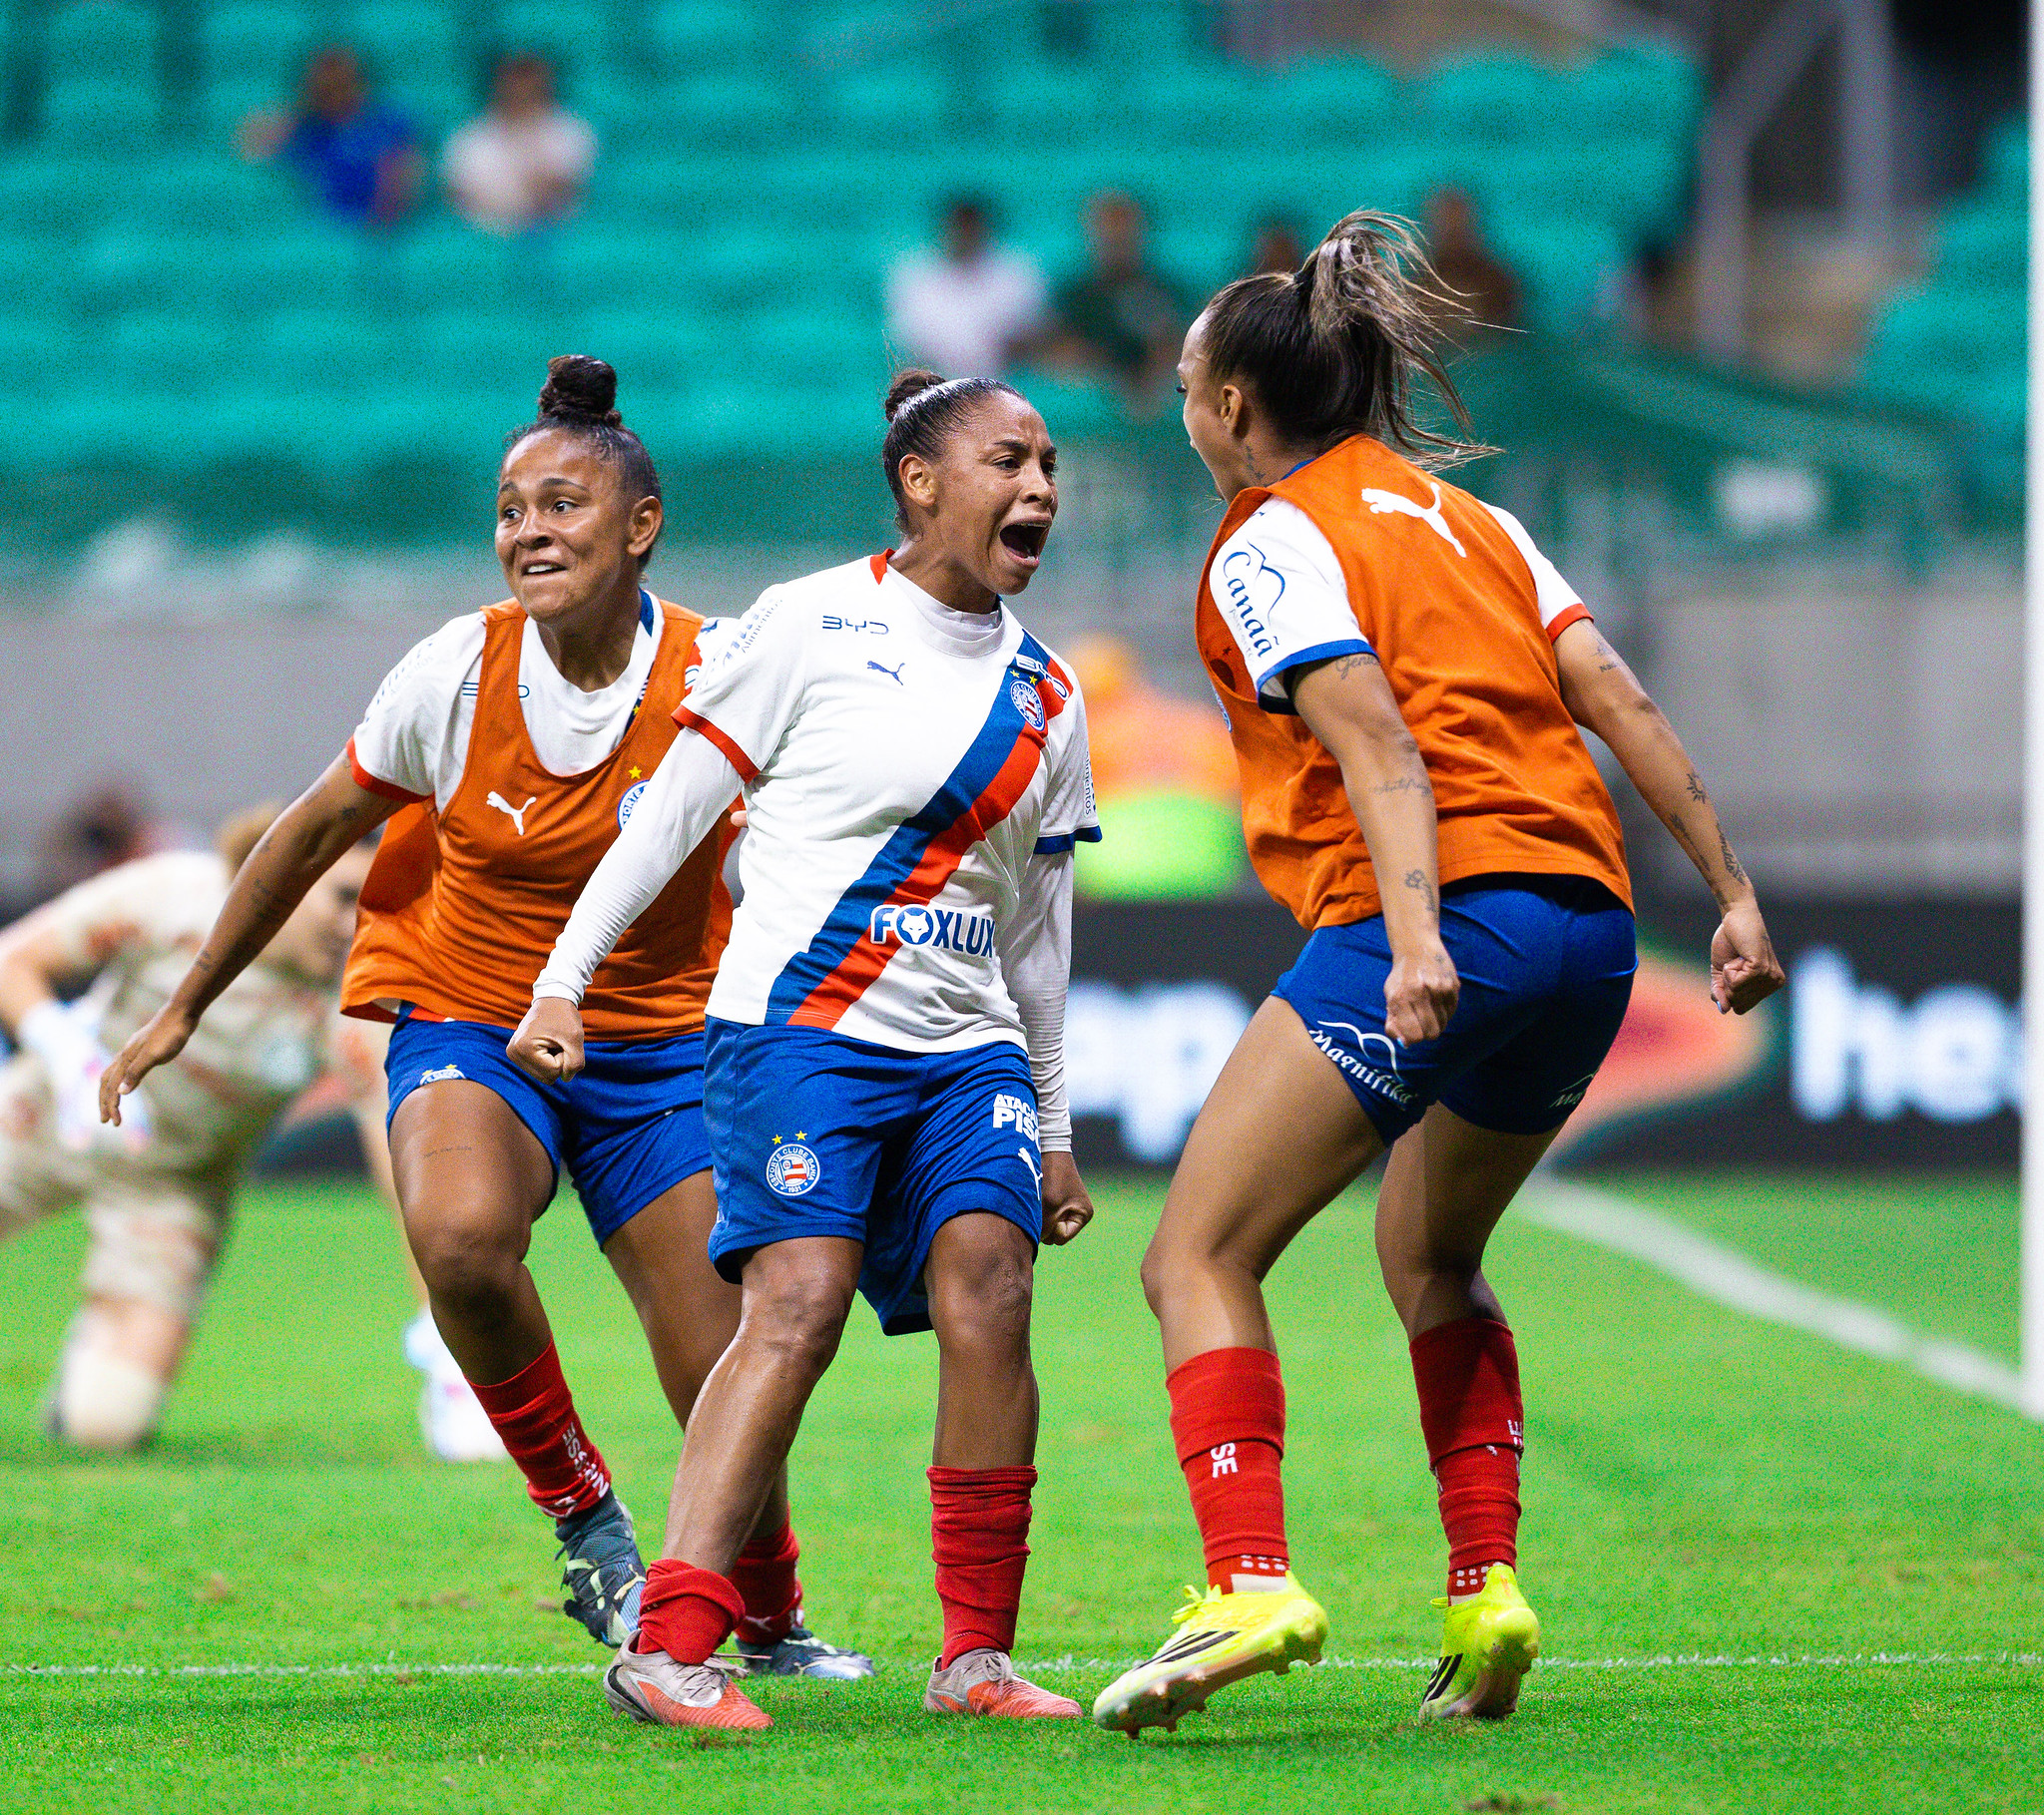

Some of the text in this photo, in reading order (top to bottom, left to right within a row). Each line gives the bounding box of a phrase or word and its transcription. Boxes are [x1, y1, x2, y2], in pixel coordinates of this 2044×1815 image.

[821, 615, 890, 636] BYD
[1223, 551, 1280, 659] Canaã
[870, 904, 996, 959] FOXLUX
[782, 1146, 809, 1158] CLUBE
[807, 1157, 817, 1181] BAHIA
